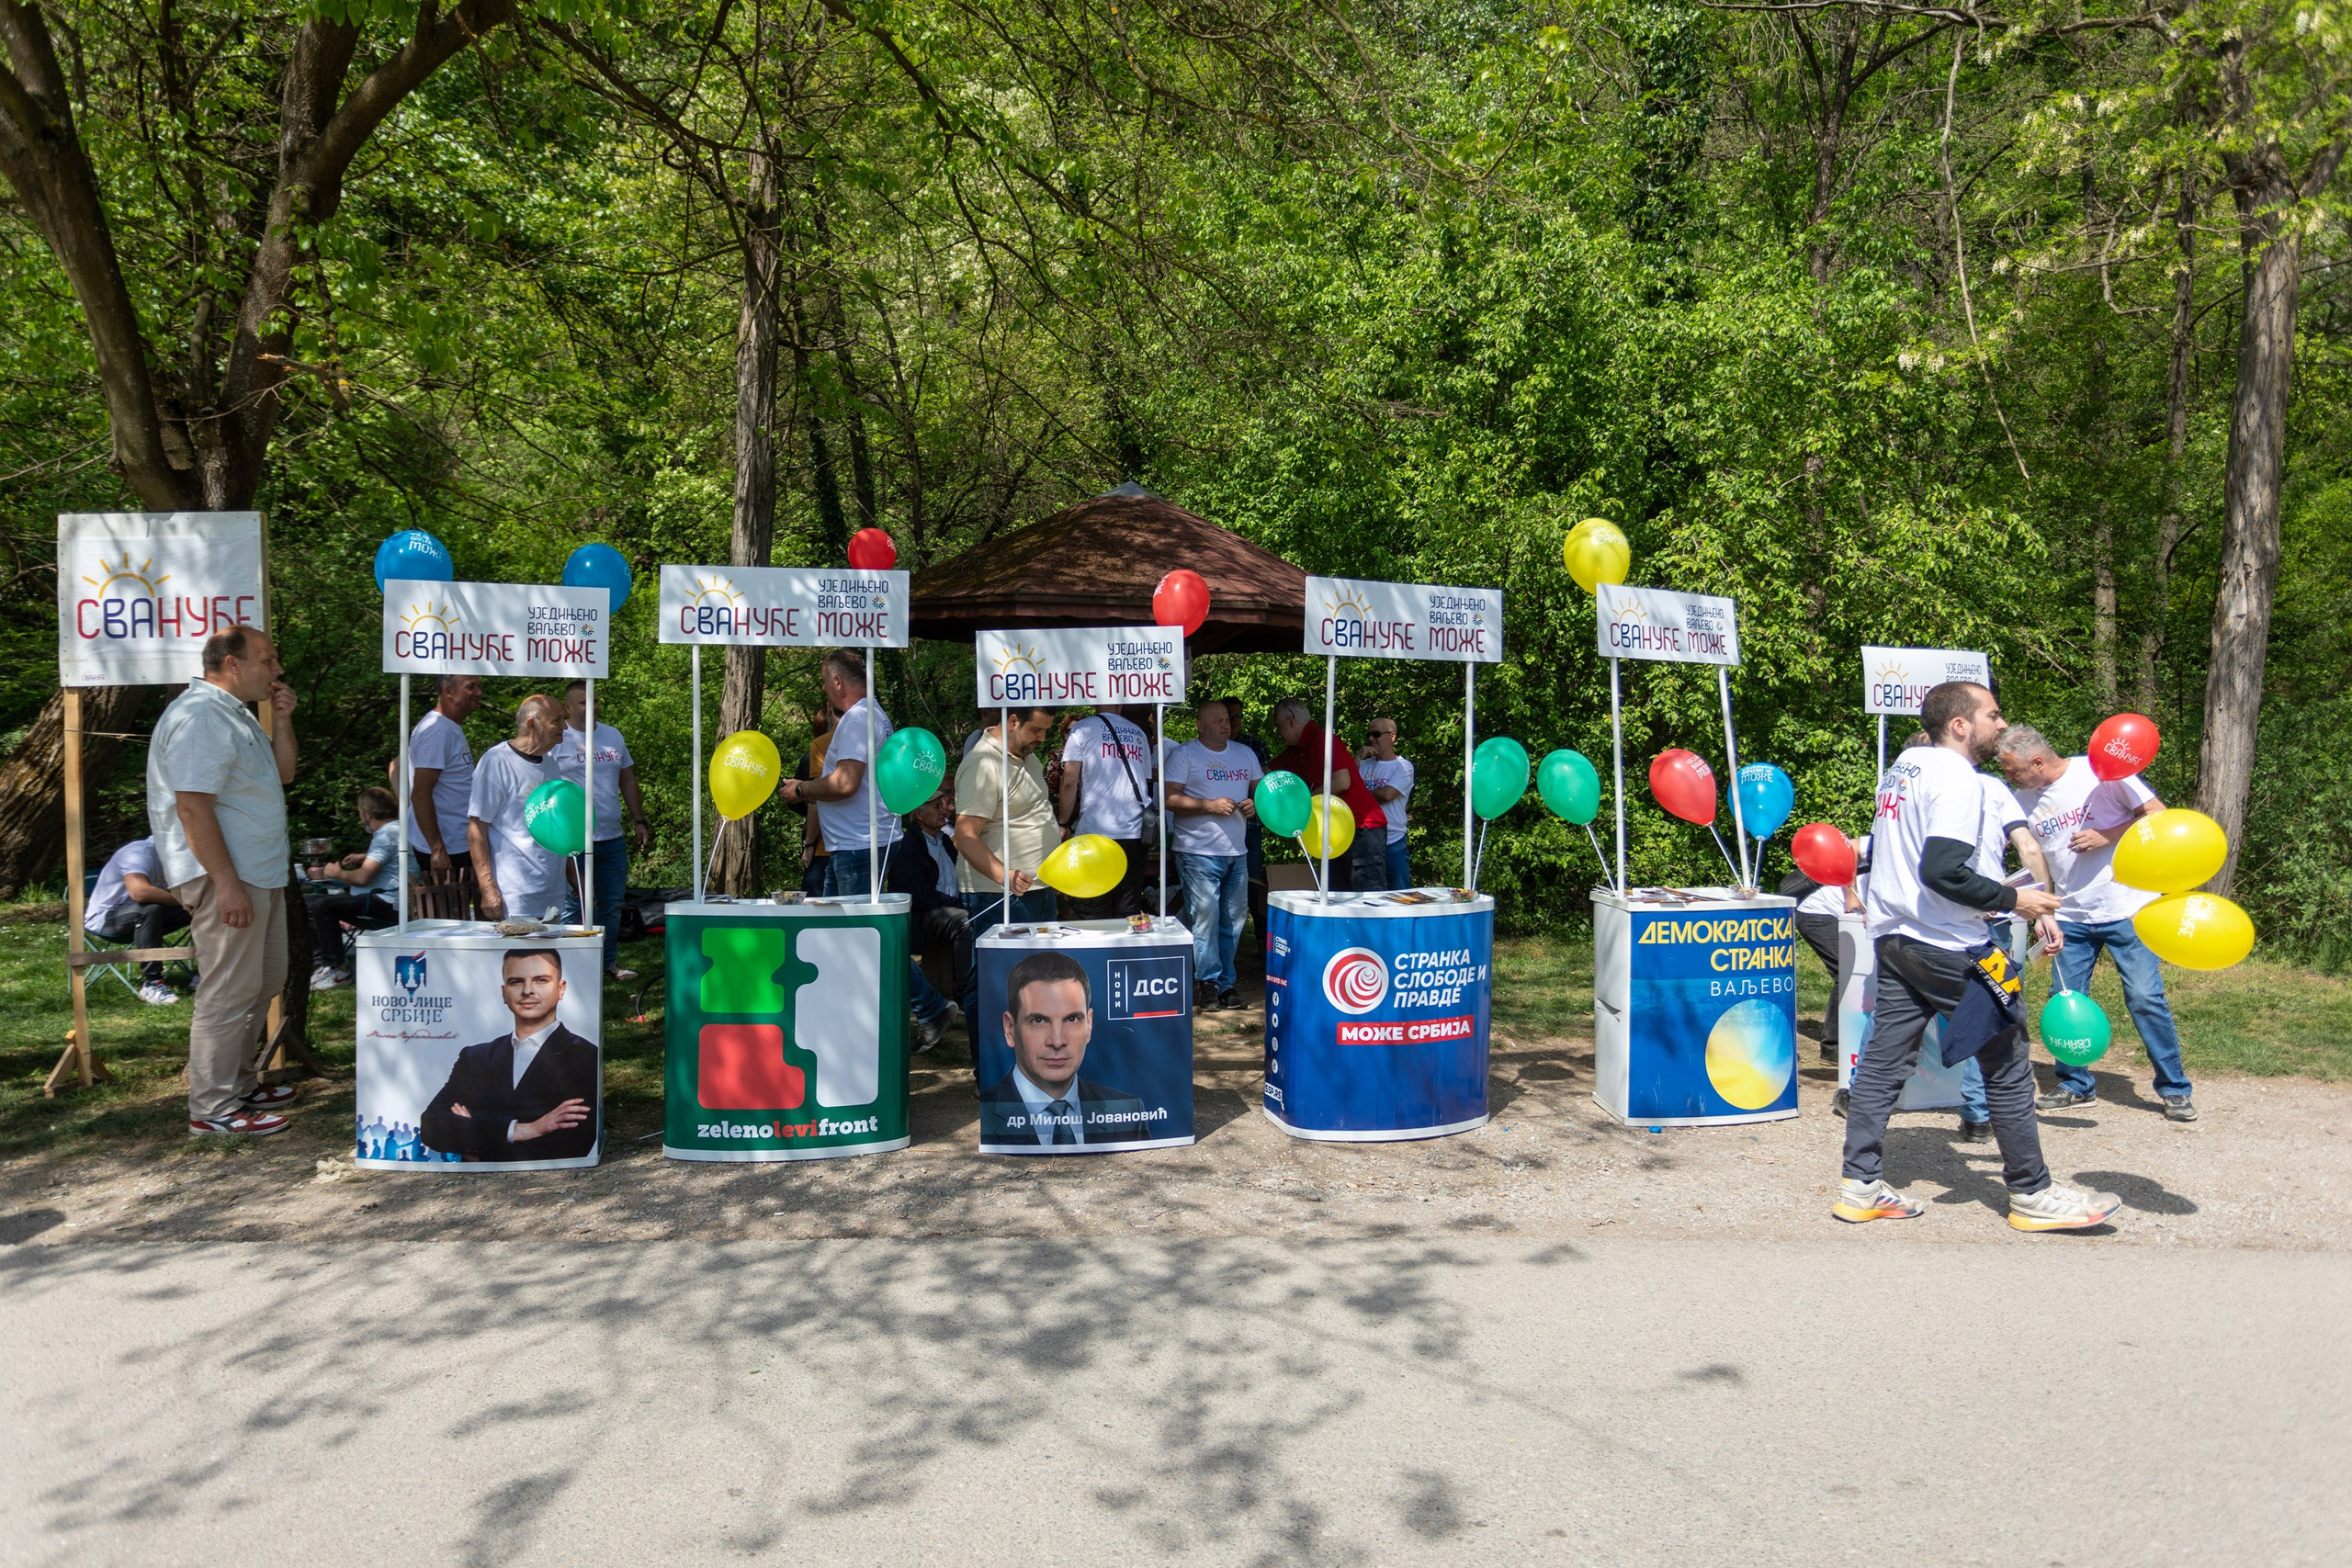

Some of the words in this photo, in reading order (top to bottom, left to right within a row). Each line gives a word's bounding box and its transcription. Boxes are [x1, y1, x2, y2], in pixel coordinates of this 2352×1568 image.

[818, 580, 888, 593] УЈЕДИЊЕНО
[818, 595, 866, 609] ВАЉЕВО
[1429, 595, 1486, 612] УЈЕДИЊЕНО
[1685, 604, 1724, 620] УЈЕДИЊЕНО
[527, 606, 598, 622] УЈЕДИЊЕНО
[680, 605, 800, 637] СВАНУЋЕ
[1429, 611, 1468, 626] ВАЉЕВО
[1686, 617, 1713, 631] ВАЉЕВО
[527, 622, 575, 636] ВАЉЕВО
[817, 612, 888, 638] МОЖЕ
[1321, 617, 1416, 650] СВАНУЋЕ
[395, 630, 514, 661] СВАНУЋЕ
[1429, 626, 1486, 653] МОЖЕ
[1610, 622, 1680, 651] СВАНУЋЕ
[1688, 631, 1727, 656] МОЖЕ
[526, 637, 596, 663] МОЖЕ
[1107, 641, 1172, 656] УЈЕДИЊЕНО
[1108, 657, 1153, 671] ВАЉЕВО
[989, 671, 1097, 701] СВАНУЋЕ
[1108, 672, 1173, 698] МОЖЕ
[1102, 733, 1133, 743] ВАЕВО
[1102, 742, 1143, 763] МОЖЕ
[2103, 742, 2143, 768] СВАНУЋЕ
[723, 753, 769, 780] СВАНУЋЕ
[1206, 768, 1249, 782] СВАНУЋЕ
[1267, 776, 1297, 794] МОЖЕ
[1741, 772, 1774, 784] МОЖЕ
[2034, 805, 2095, 838] СВАНУЋЕ
[1638, 918, 1792, 944] ДЕМОКРАТСКА
[1395, 948, 1471, 970] СТРАНКА
[1711, 945, 1792, 971] СТРАНКА
[1133, 977, 1178, 997] ДСС
[1394, 968, 1475, 989] СЛОБОДЕ
[1476, 964, 1487, 980] И
[1711, 976, 1792, 997] ВАЉЕВО
[372, 996, 407, 1007] НОВО
[413, 997, 453, 1010] ЛИЦЕ
[1393, 987, 1461, 1008] ПРАВДЕ
[381, 1008, 443, 1026] СРБИЈЕ
[1341, 1024, 1404, 1042] МОЖЕ
[1408, 1020, 1471, 1039] СРБИЈА
[697, 1115, 878, 1139] zelenolevifront
[1007, 1115, 1025, 1129] др
[1030, 1112, 1082, 1127] Милош
[1087, 1107, 1168, 1124] Јовановић
